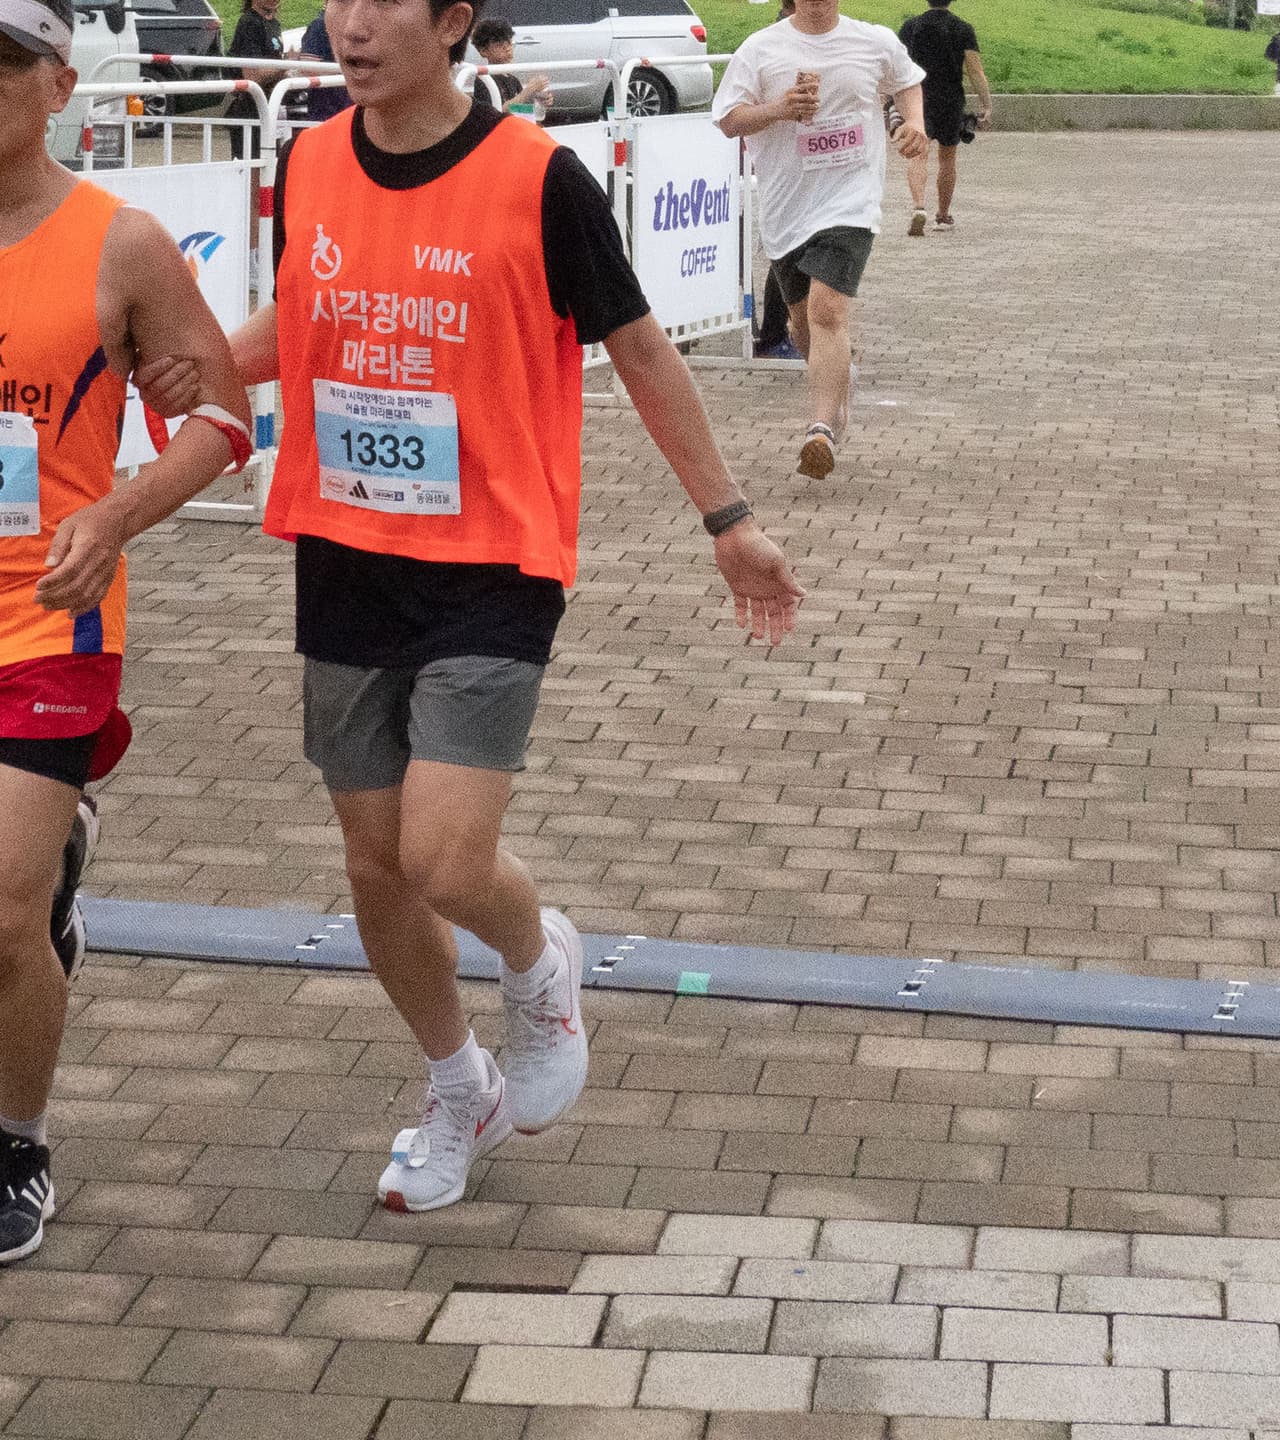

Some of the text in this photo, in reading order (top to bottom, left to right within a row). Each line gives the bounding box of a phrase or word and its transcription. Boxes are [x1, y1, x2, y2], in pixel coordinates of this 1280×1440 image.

[808, 129, 857, 153] 50678
[414, 244, 475, 277] VMK
[680, 244, 718, 279] COFFEE
[311, 287, 469, 344] 시각장애인
[342, 339, 436, 387] 마라톤
[340, 428, 426, 472] 1333
